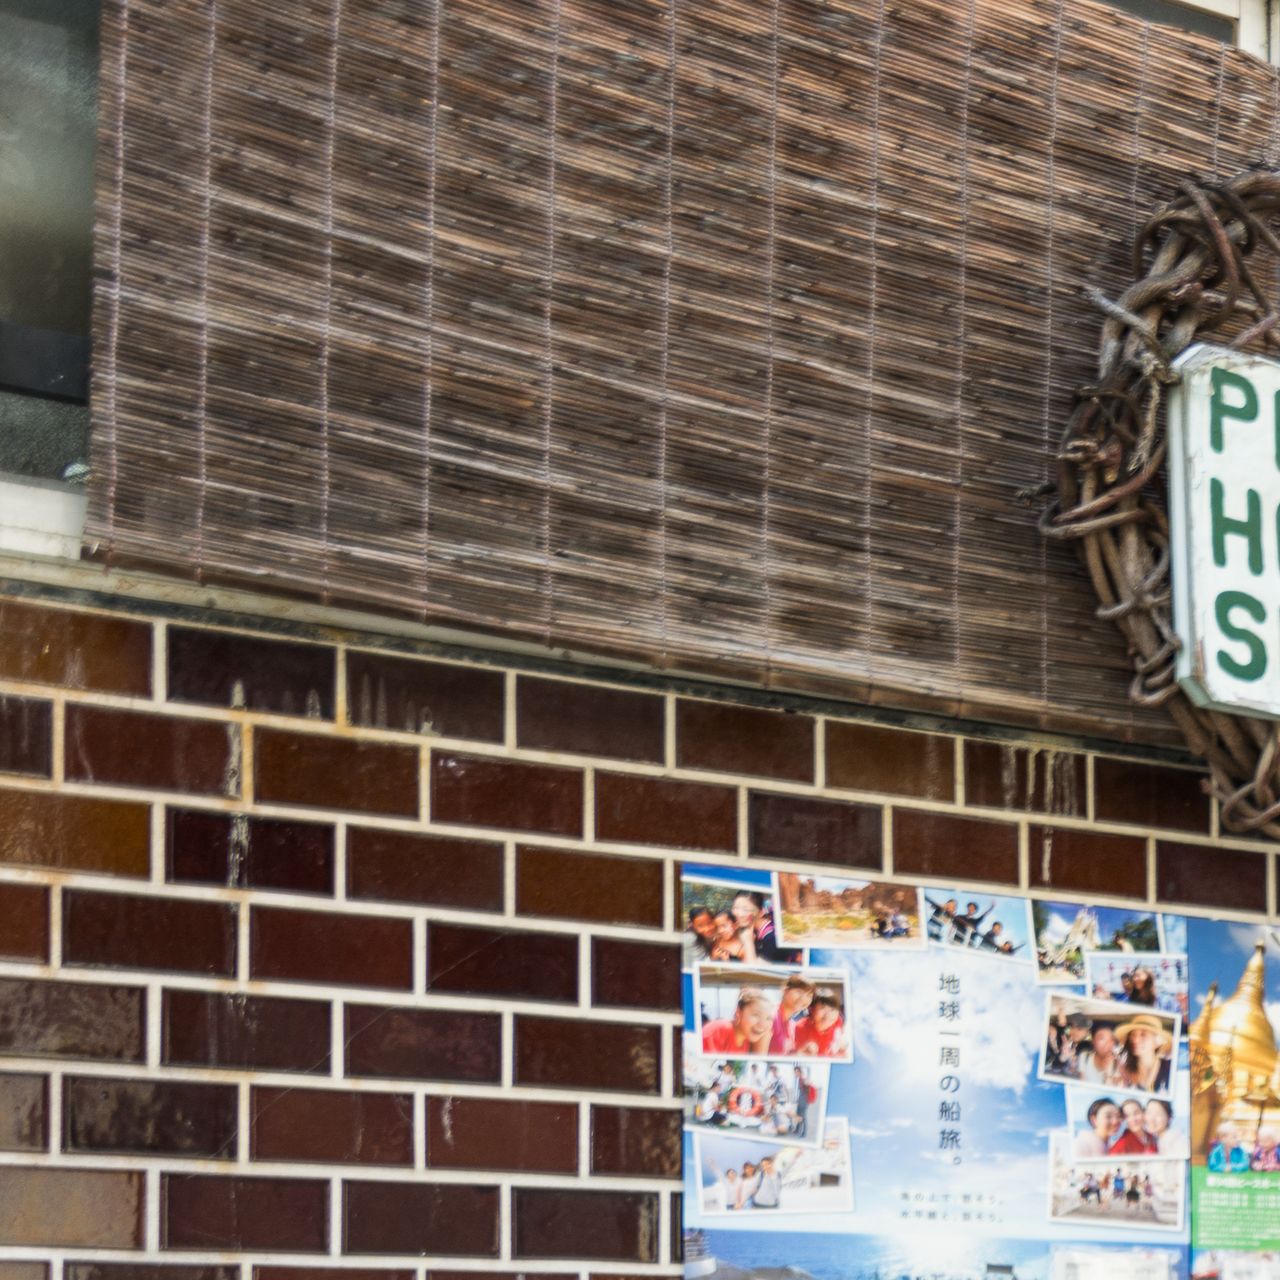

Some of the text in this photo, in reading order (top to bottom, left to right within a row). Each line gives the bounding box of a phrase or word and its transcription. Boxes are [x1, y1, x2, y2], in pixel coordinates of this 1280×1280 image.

[938, 973, 962, 1165] 地球一周の船旅。
